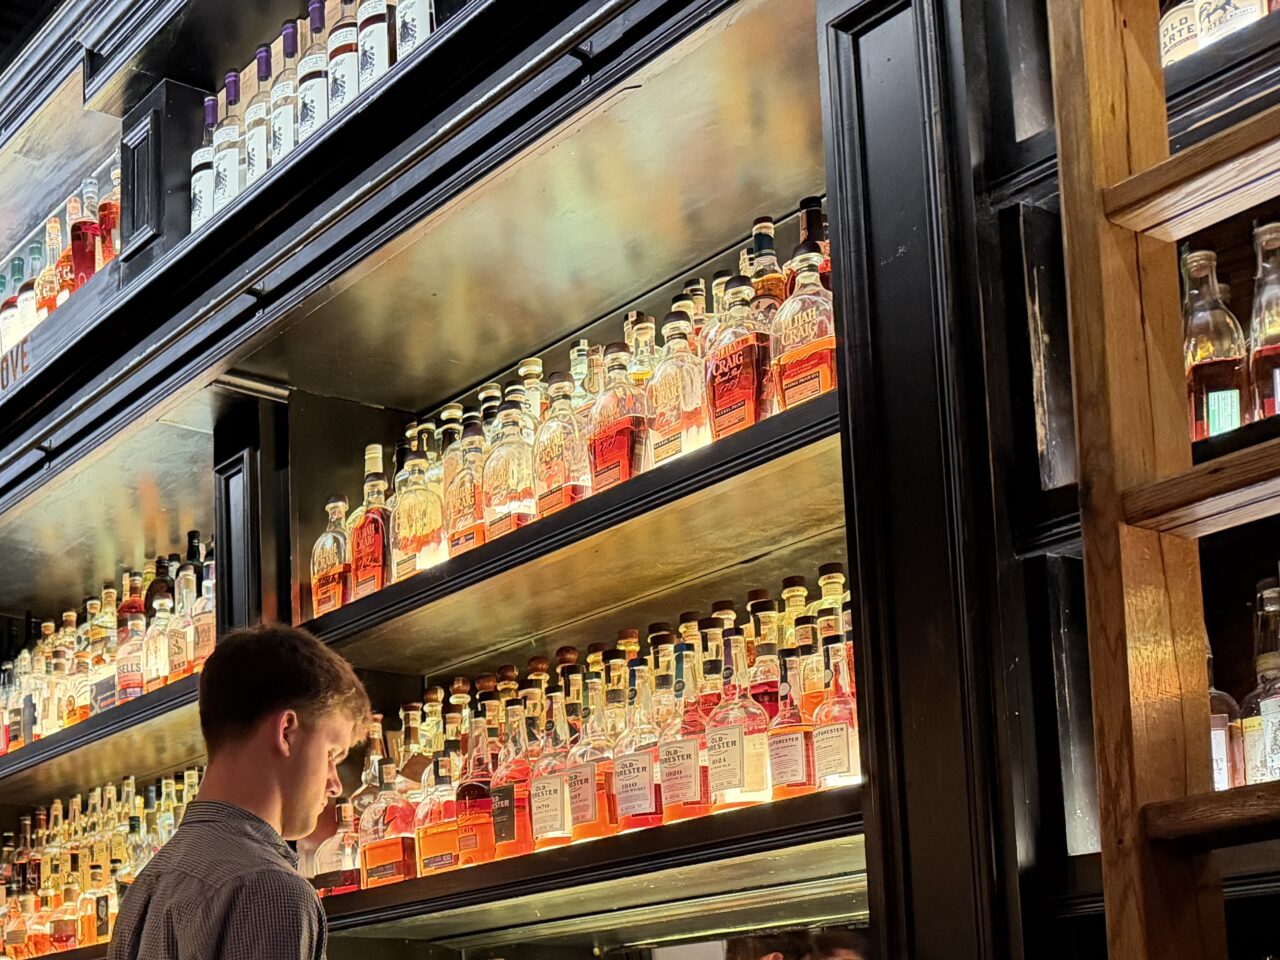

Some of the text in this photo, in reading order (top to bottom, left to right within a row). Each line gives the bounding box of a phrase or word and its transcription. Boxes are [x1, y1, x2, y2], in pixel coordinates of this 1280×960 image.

[1163, 16, 1188, 38] OLD
[1162, 23, 1195, 50] ARTE
[781, 320, 818, 345] CRAIG
[712, 351, 744, 376] CRAIG
[708, 740, 737, 752] RESTER
[661, 753, 692, 765] ORESTER
[665, 749, 678, 757] OLD
[616, 766, 647, 777] ORESTER
[620, 762, 634, 770] OLD
